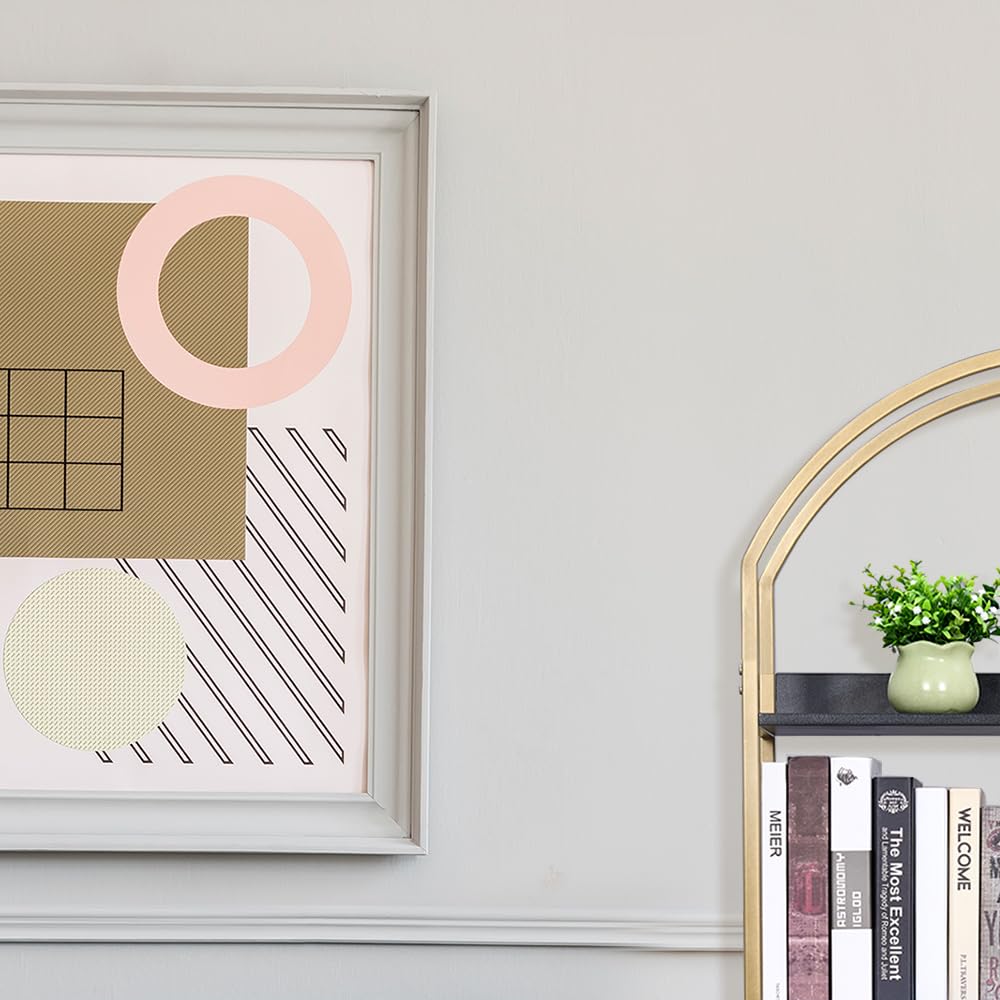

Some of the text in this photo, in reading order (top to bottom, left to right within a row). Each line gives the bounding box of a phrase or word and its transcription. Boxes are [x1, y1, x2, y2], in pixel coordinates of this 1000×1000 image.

[769, 810, 782, 858] MEIER
[881, 826, 889, 841] and
[957, 807, 972, 891] WELCOME
[881, 841, 889, 882] Lamentable
[835, 852, 847, 928] ASTRONOMY
[880, 883, 889, 911] Tragedy
[889, 827, 904, 981] The Most Excellent
[852, 891, 862, 928] IGLOO
[881, 920, 889, 946] Romeo
[881, 946, 889, 961] and
[881, 961, 889, 981] Juliet
